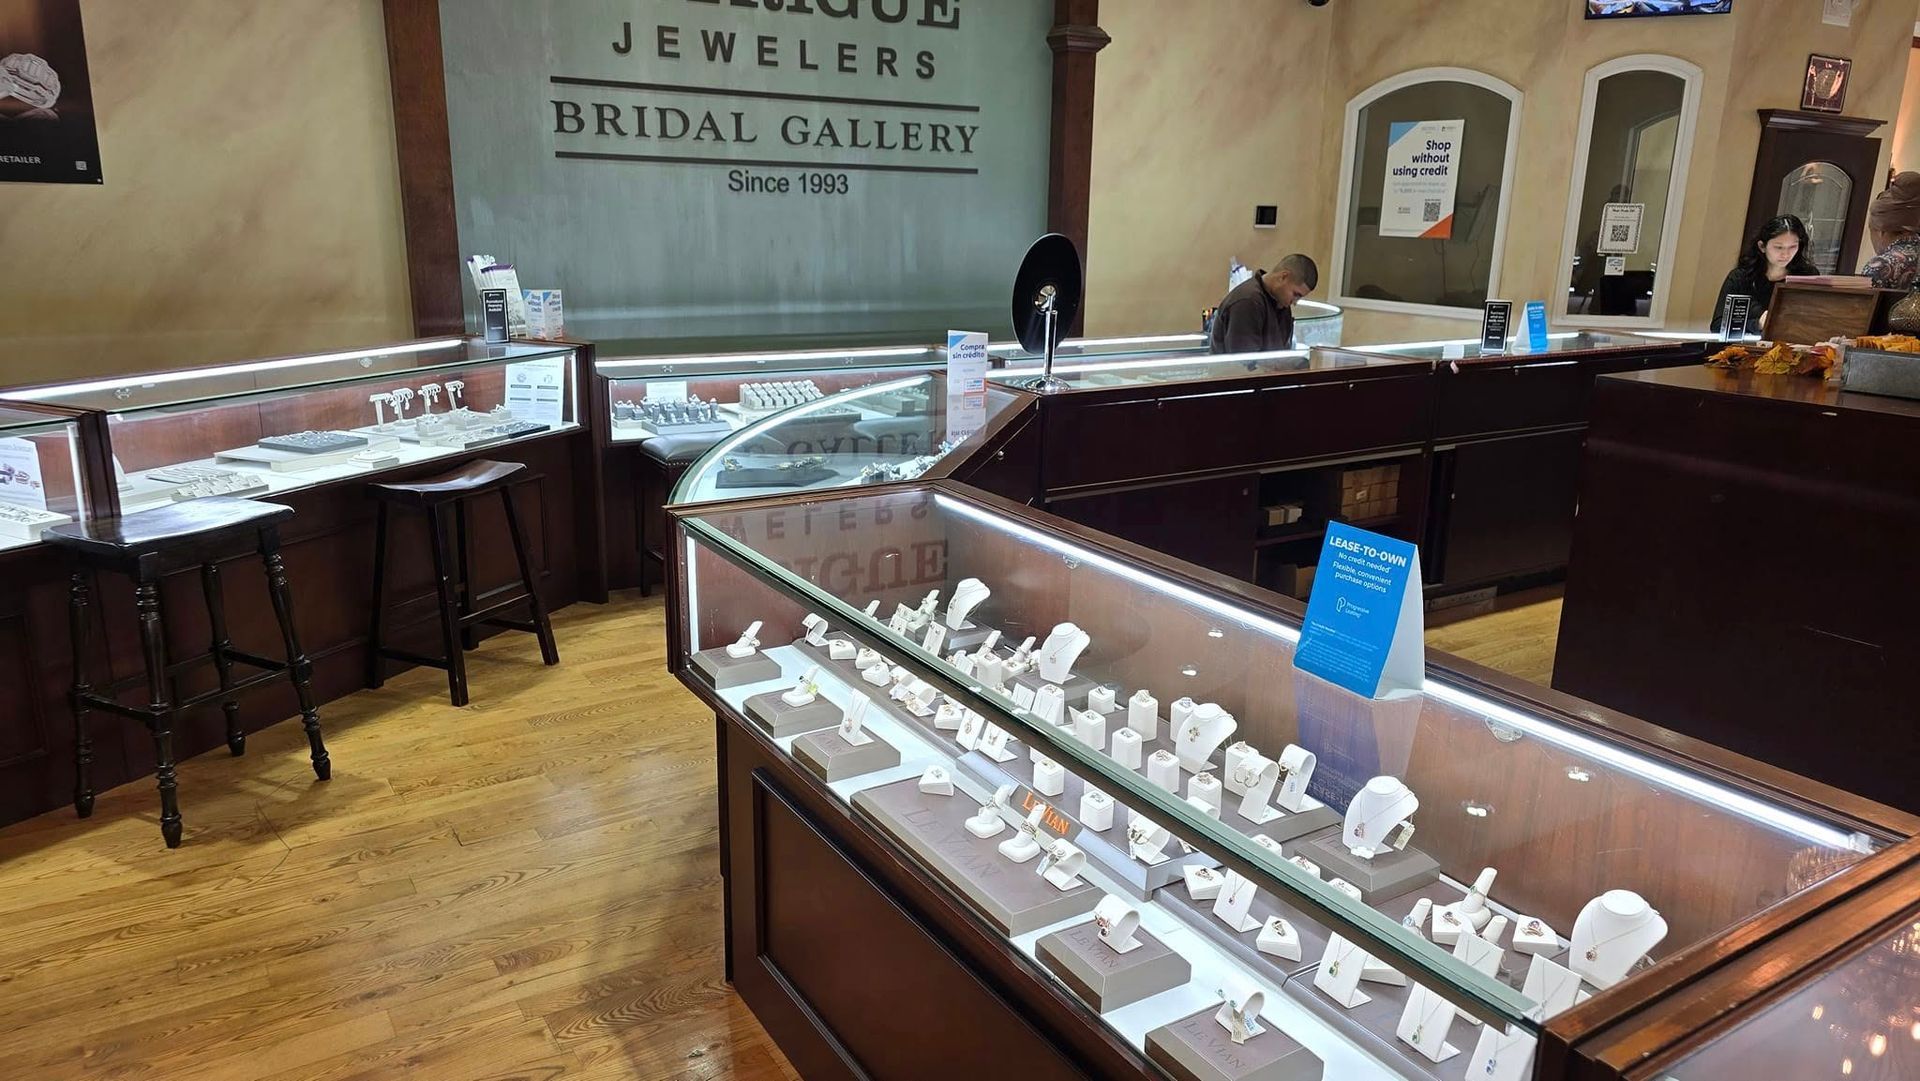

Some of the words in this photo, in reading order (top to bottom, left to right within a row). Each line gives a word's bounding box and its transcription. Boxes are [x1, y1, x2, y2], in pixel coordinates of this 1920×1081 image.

[611, 21, 936, 80] JEWELERS
[550, 100, 758, 145] BRIDAL
[780, 115, 980, 153] GALLERY
[1426, 140, 1452, 152] Shop
[1412, 152, 1450, 163] without
[1392, 166, 1419, 178] using
[1419, 165, 1448, 176] credit
[728, 170, 790, 194] Since
[797, 173, 849, 196] 1993
[960, 344, 985, 352] Compra
[962, 351, 985, 359] crédito
[1329, 536, 1407, 567] LEASE-TO-OWN
[1338, 551, 1347, 559] No
[1347, 555, 1365, 566] credit
[1333, 561, 1356, 574] Flexible,
[1357, 571, 1392, 586] convenient
[1335, 571, 1362, 586] purchase
[1363, 581, 1387, 593] options
